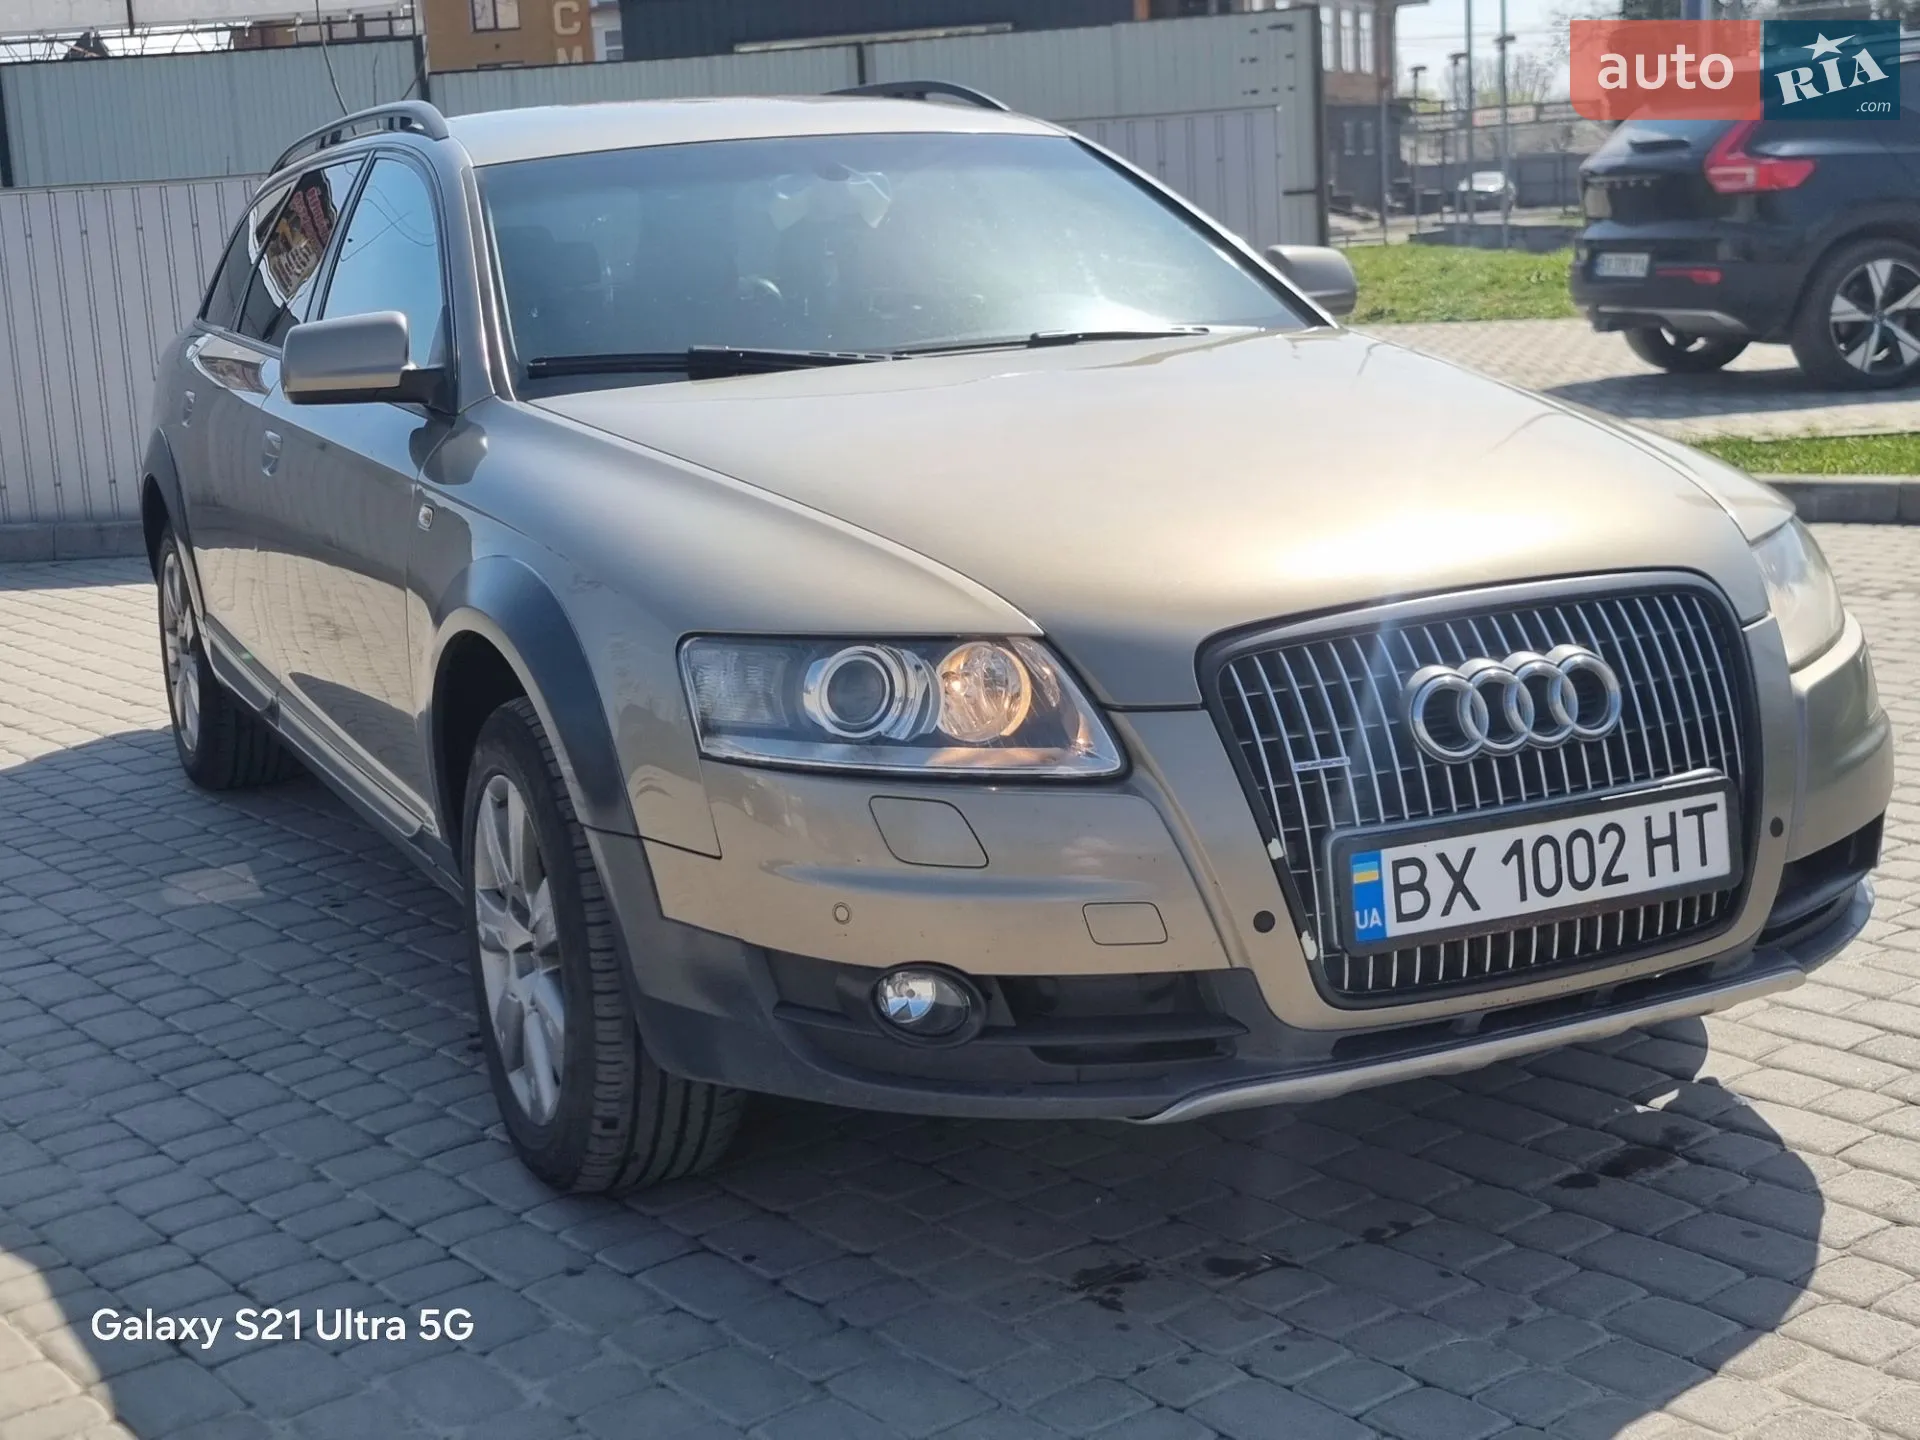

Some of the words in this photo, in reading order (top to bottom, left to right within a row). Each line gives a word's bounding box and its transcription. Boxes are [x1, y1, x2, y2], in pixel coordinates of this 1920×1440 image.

[1391, 846, 1481, 923] BX
[1501, 821, 1630, 902] 1002
[1644, 802, 1718, 878] HT
[1354, 907, 1383, 929] UA
